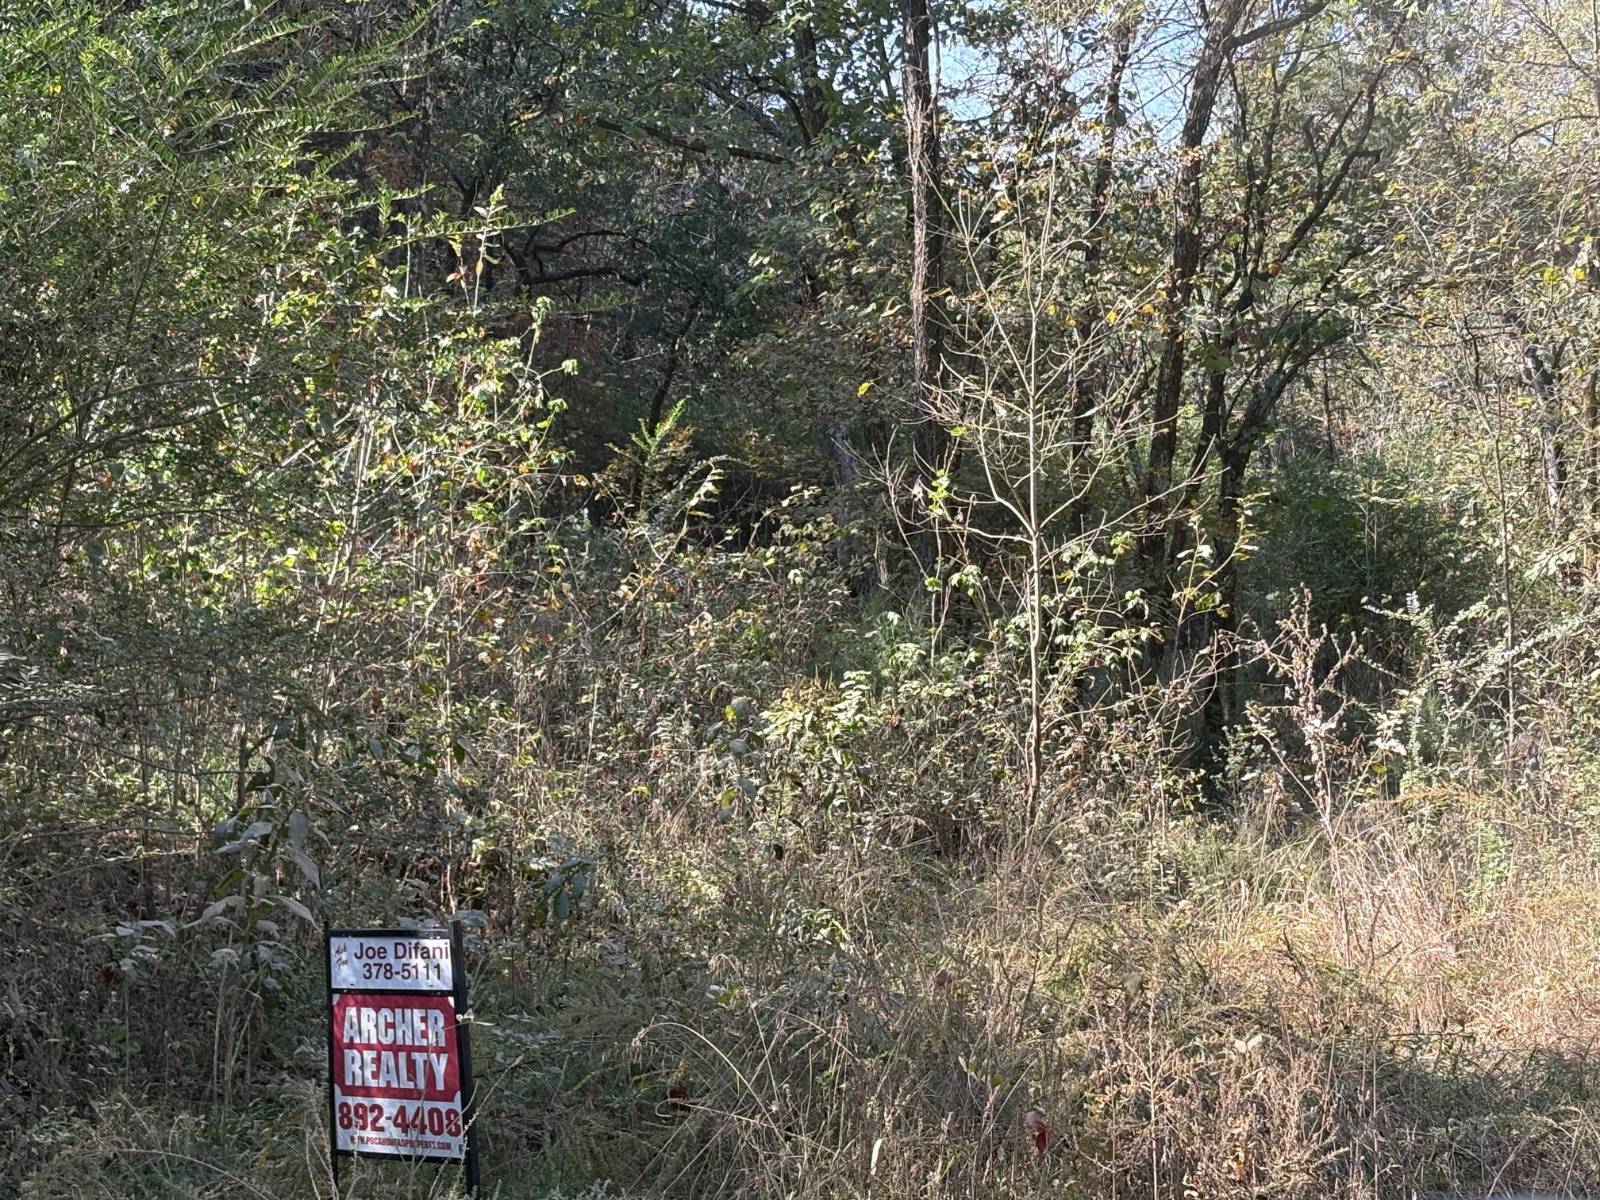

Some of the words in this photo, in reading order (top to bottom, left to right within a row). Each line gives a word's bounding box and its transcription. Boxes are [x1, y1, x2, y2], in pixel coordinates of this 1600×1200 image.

[354, 942, 387, 960] Joe
[394, 942, 449, 959] Difani
[363, 963, 441, 980] 378-5111
[343, 1006, 446, 1047] ARCHER
[343, 1049, 449, 1091] REALTY
[338, 1101, 461, 1137] 892-4408
